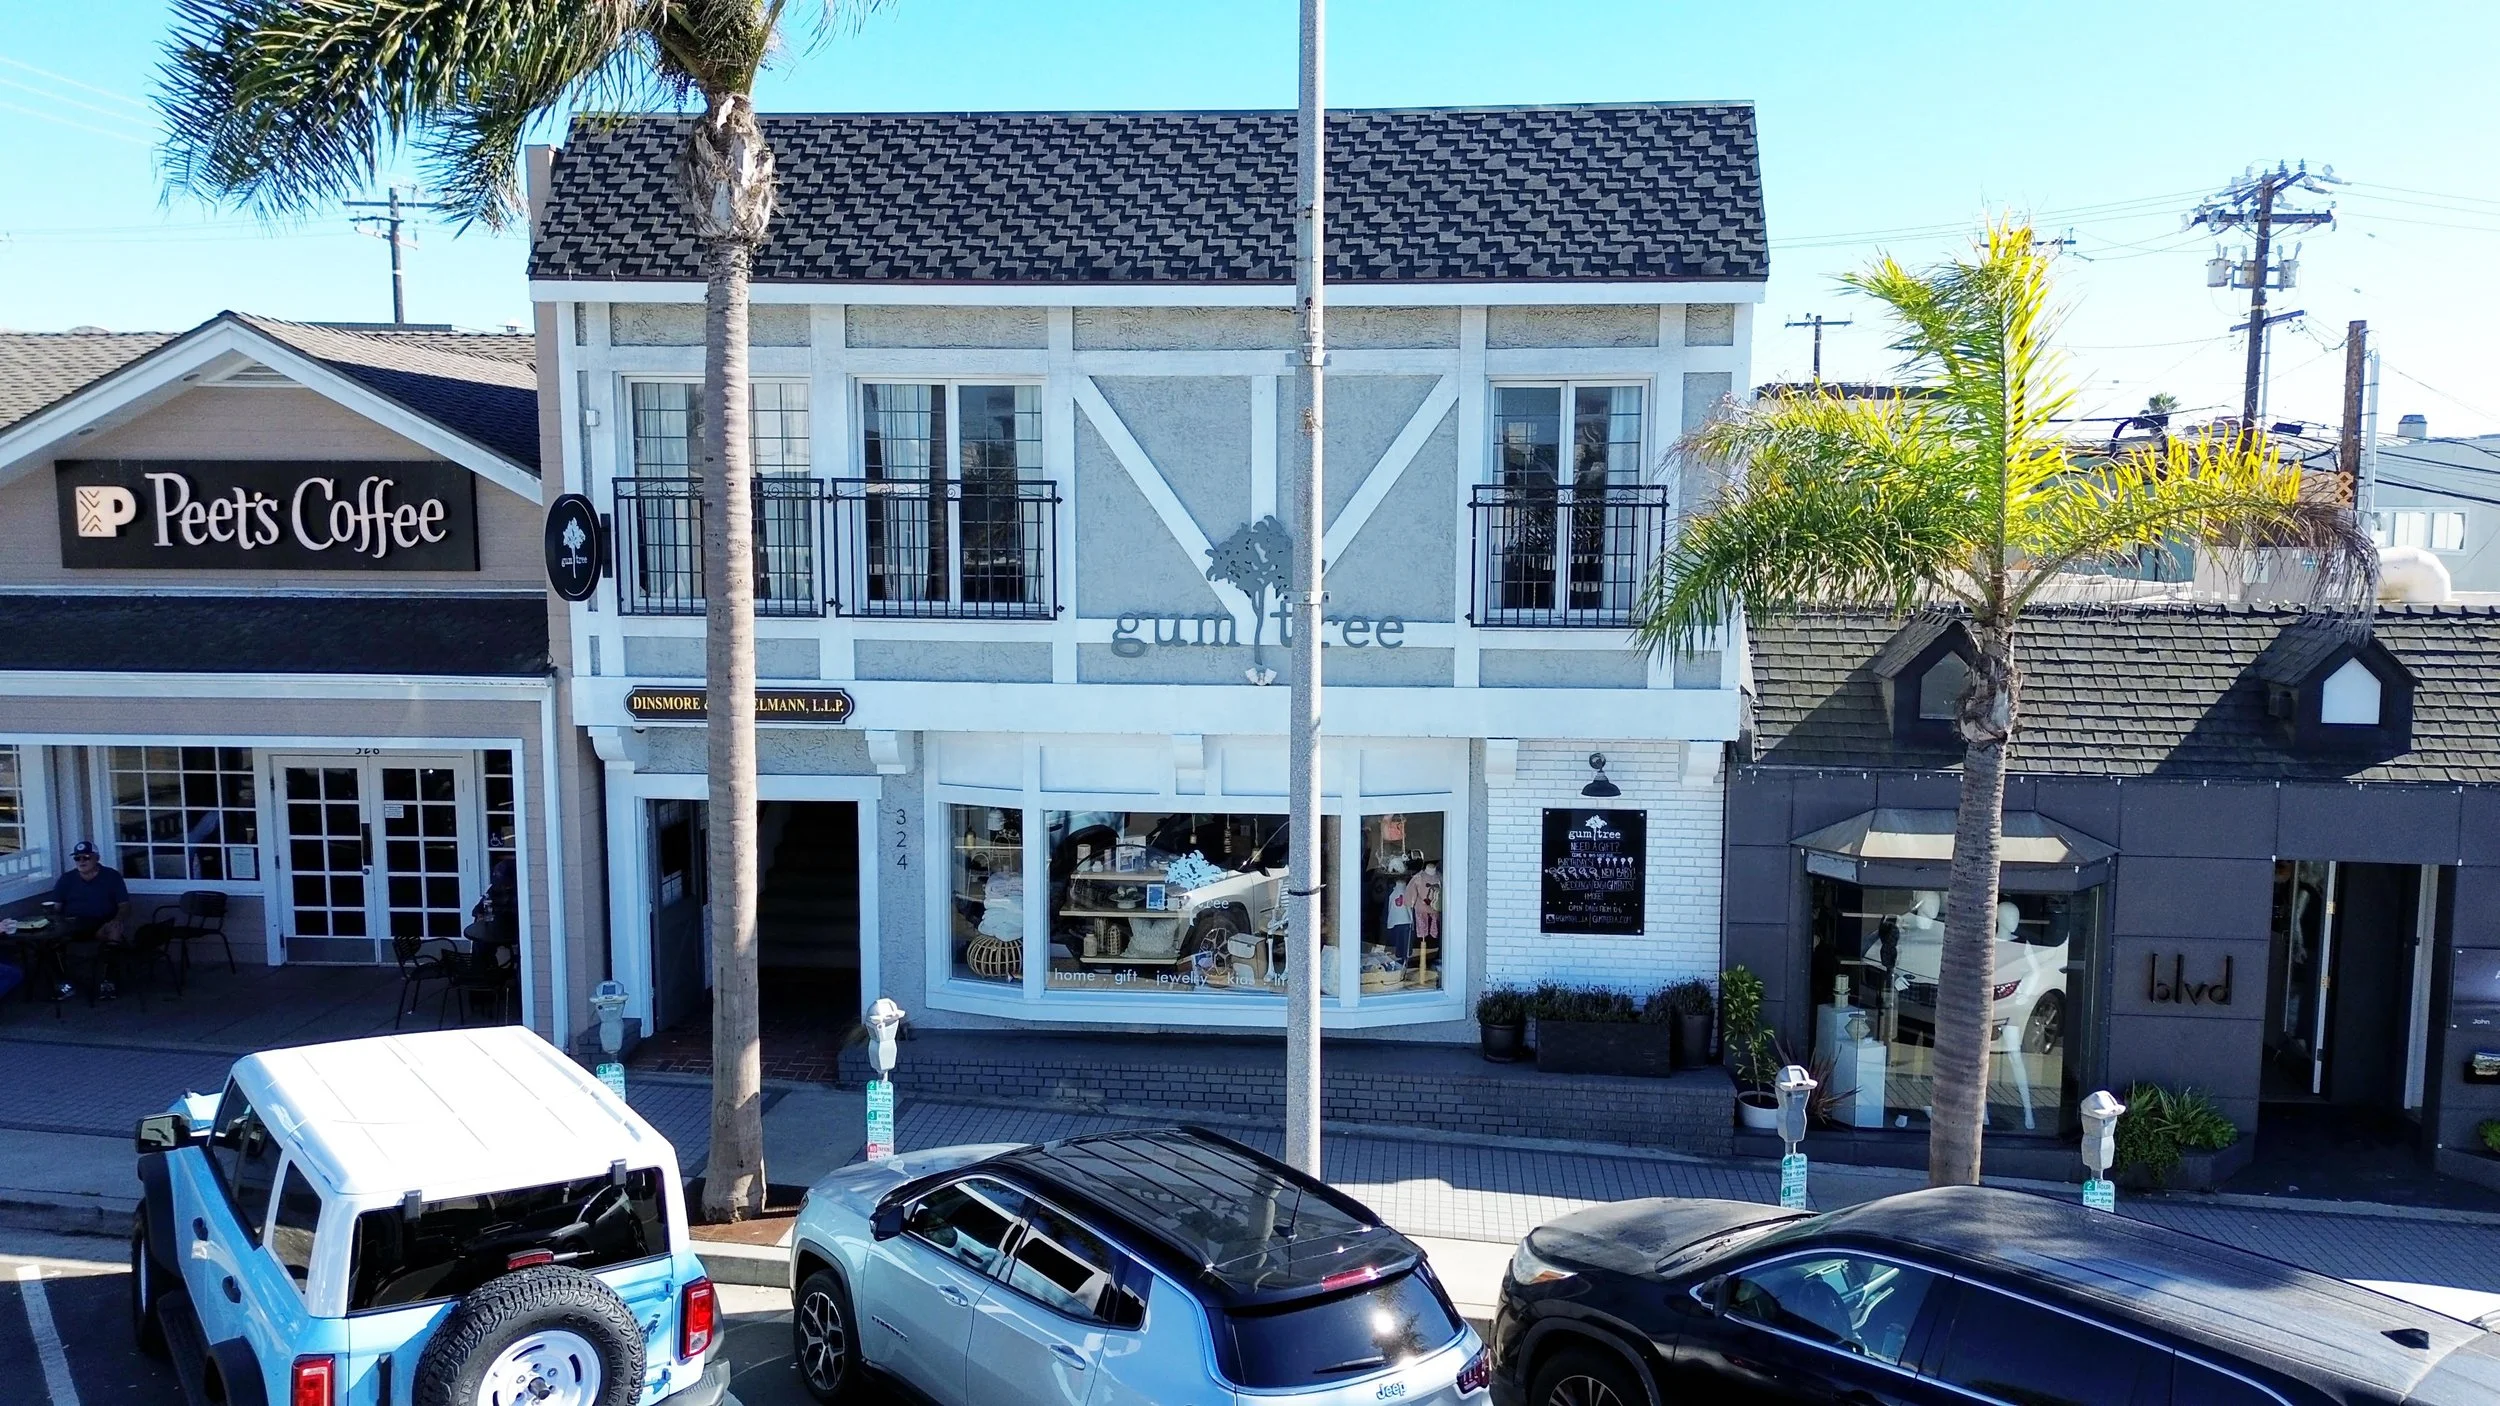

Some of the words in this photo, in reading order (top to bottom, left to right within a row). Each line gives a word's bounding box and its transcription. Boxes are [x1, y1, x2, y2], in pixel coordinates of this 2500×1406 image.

[145, 472, 280, 550] Peet's
[292, 476, 447, 558] Coffee
[1111, 612, 1241, 658] gum
[633, 696, 701, 710] DINSMORE
[812, 699, 844, 712] L.L.P.
[896, 808, 908, 871] 324
[1568, 830, 1592, 840] gum
[1597, 830, 1621, 839] tree
[1570, 842, 1590, 851] NEED
[1592, 842, 1598, 850] A
[1598, 842, 1620, 852] GIFT?
[1055, 968, 1095, 982] home
[1114, 969, 1138, 985] gift
[1156, 970, 1208, 987] jewelry
[2149, 953, 2233, 1006] blvd
[1376, 1382, 1405, 1400] Jeep
